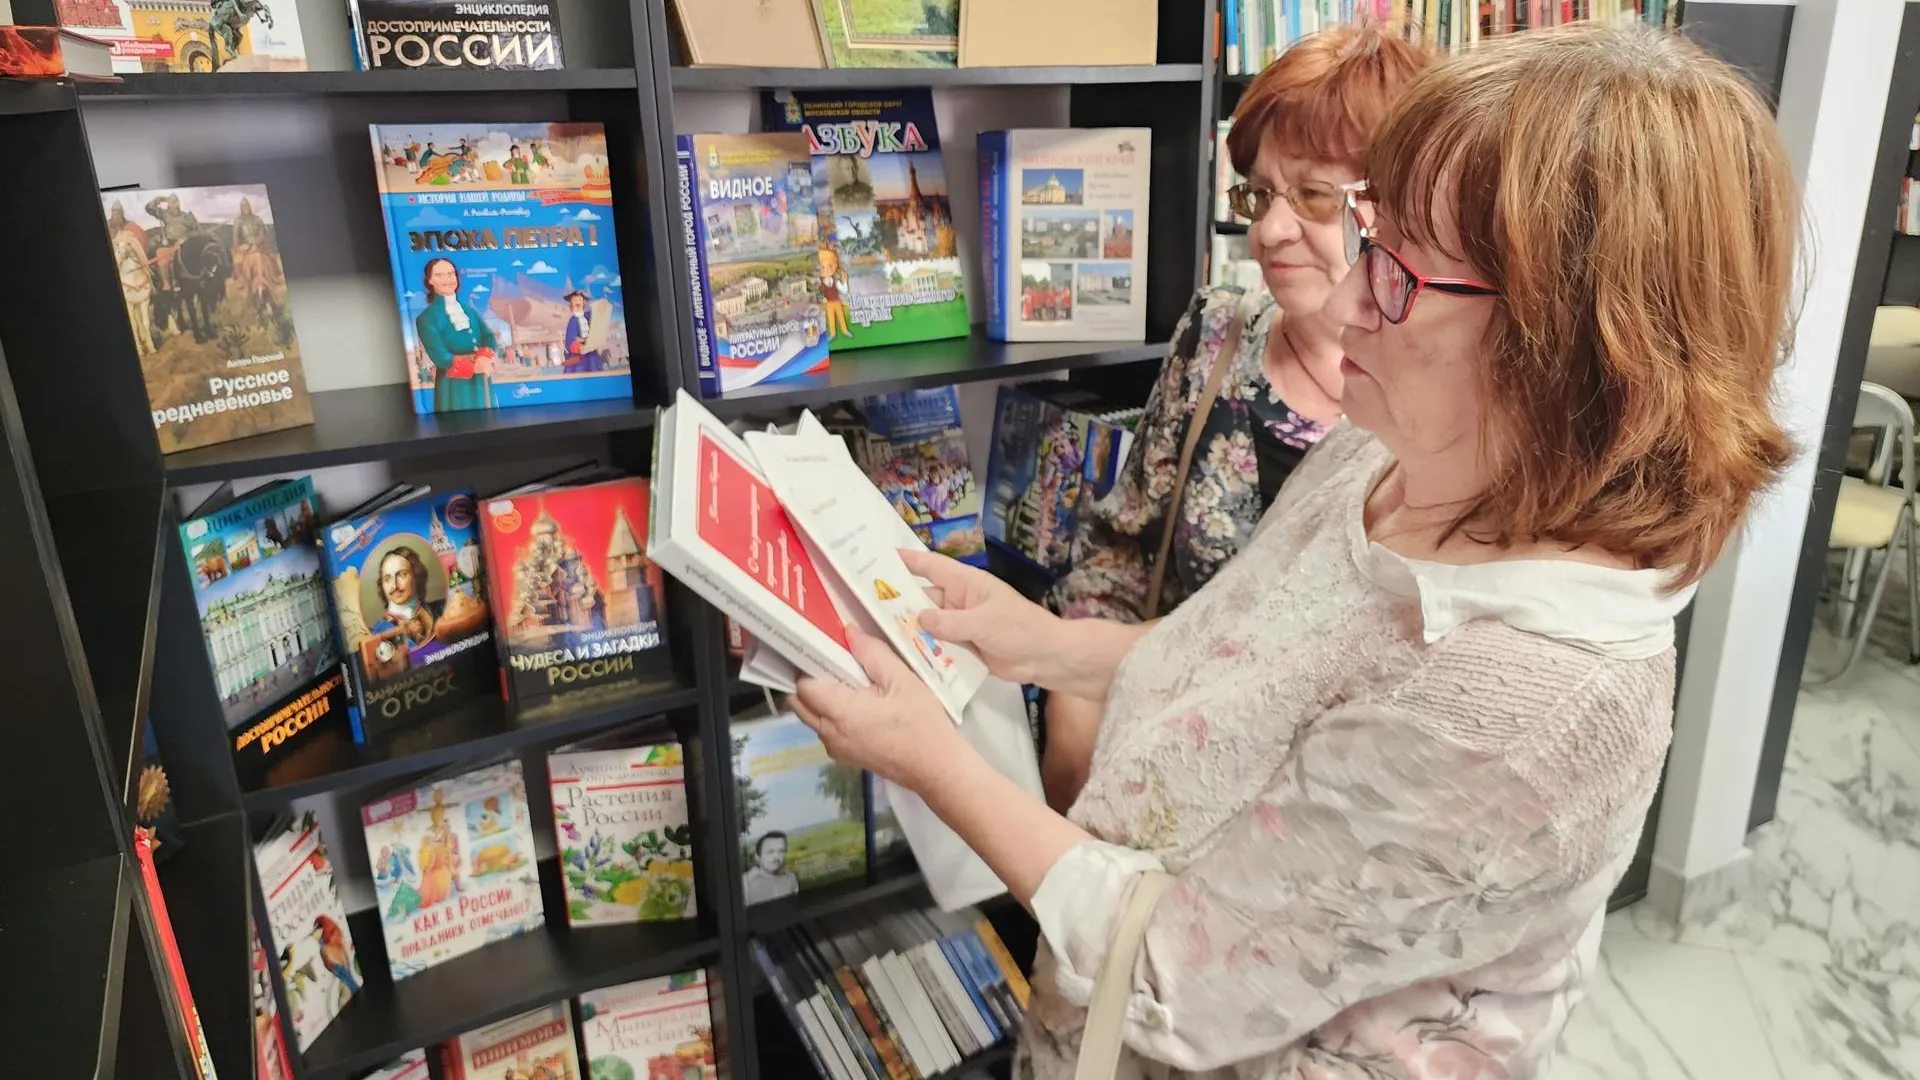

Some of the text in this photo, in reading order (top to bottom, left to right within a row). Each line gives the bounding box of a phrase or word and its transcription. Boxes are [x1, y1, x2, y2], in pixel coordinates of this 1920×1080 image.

[454, 3, 549, 15] ЭНЦИКЛОПЕДИЯ
[367, 20, 551, 34] ДОСТОПРИМЕЧАТЕЛЬНОСТИ
[369, 34, 555, 67] РОССИИ
[417, 193, 457, 204] ИСТОРИЯ
[459, 192, 489, 203] НАШЕЙ
[491, 191, 527, 202] РОДИНЫ
[678, 164, 691, 210] РОССИИ
[709, 176, 774, 200] ВИДНОЕ
[408, 228, 499, 252] ЭПОХА
[503, 224, 585, 249] ПЕТРА
[684, 211, 695, 246] ГОРОД
[687, 248, 706, 319] ЛИТЕРАТУРНЫЙ
[697, 327, 709, 367] ВИДНОЕ
[730, 321, 801, 345] ЛИТЕРАТУРНЫЙ ГОРОД
[731, 337, 781, 359] РОССИИ
[209, 369, 290, 397] Русское
[152, 386, 294, 429] редневековье
[580, 620, 658, 642] ЭНЦИКЛОПЕДИЯ
[424, 631, 490, 666] ЭНЦИКЛОПЕДИЯ
[510, 632, 661, 672] ЧУДЕСА И ЗАГАДКИ
[548, 656, 634, 687] РОССИИ
[381, 697, 401, 718] О
[260, 695, 331, 755] РОССИИ
[567, 786, 673, 808] Растения
[582, 808, 663, 826] России
[413, 912, 441, 934] КАК
[459, 887, 514, 918] РОССИИ
[401, 923, 465, 958] ПРАЗДНИКИ
